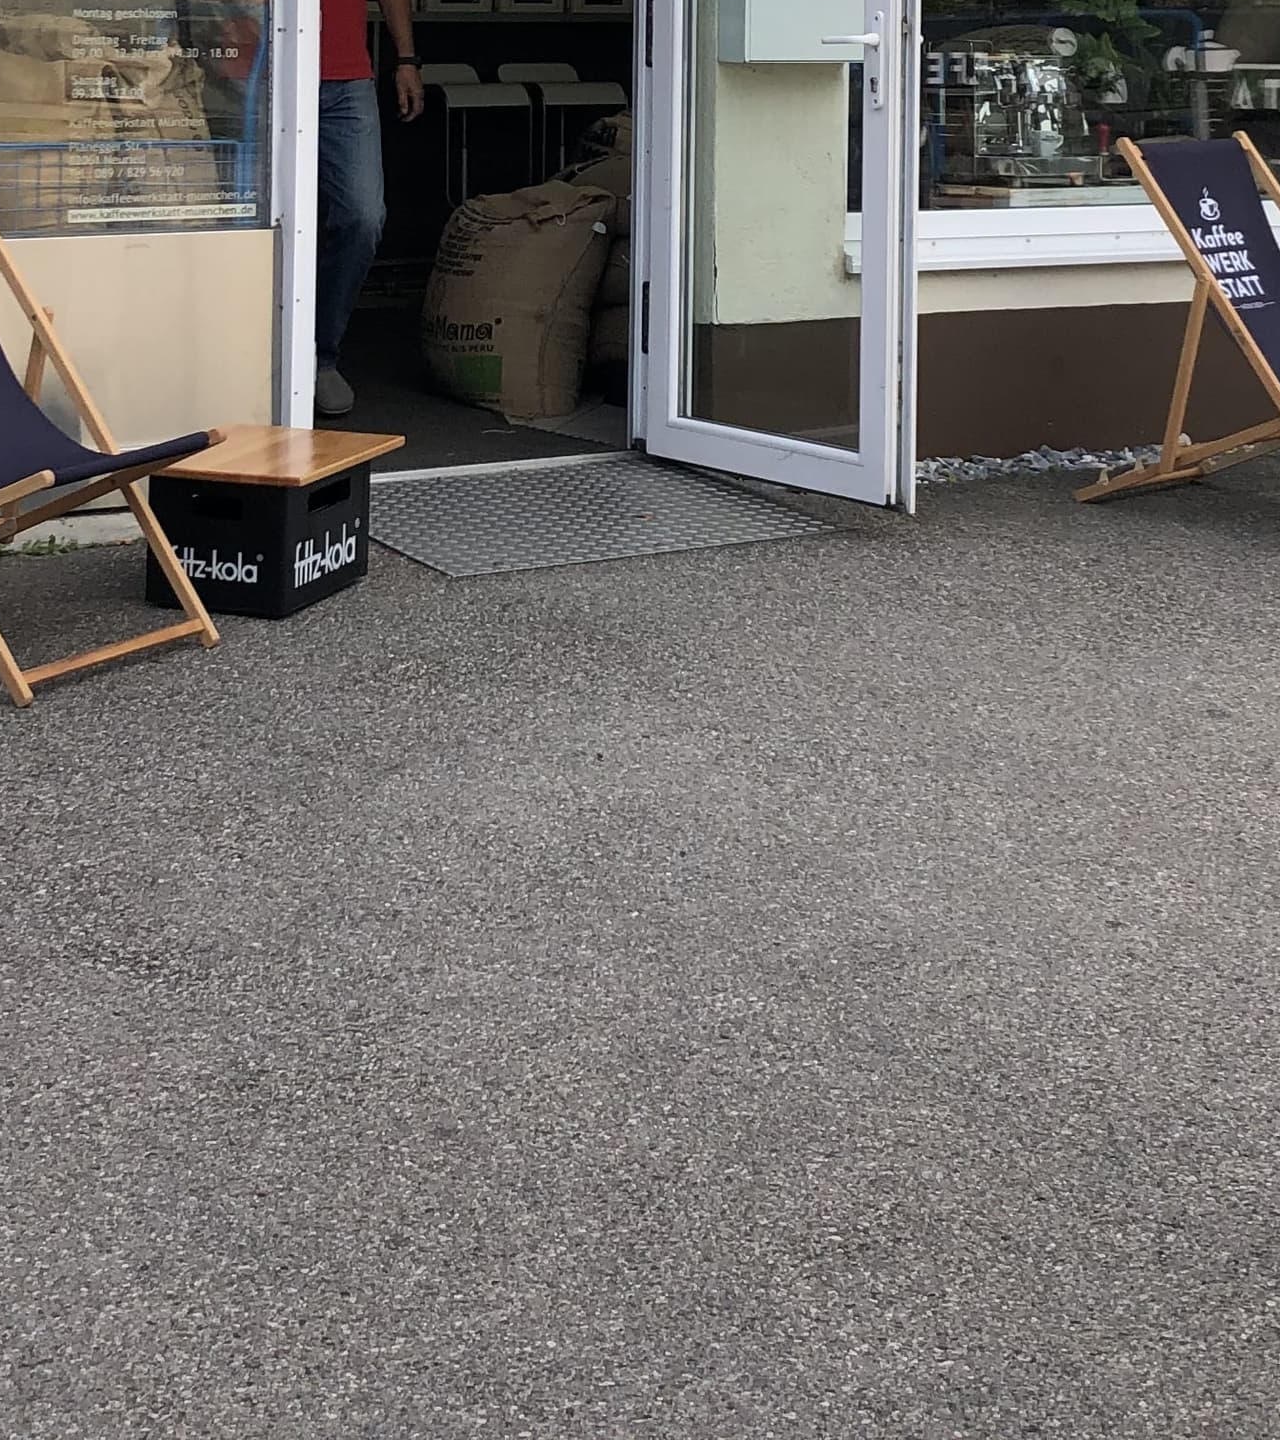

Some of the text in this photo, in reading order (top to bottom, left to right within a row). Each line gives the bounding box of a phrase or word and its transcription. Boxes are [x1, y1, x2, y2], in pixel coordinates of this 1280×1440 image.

[209, 47, 239, 58] 18.00
[1191, 224, 1245, 249] Kaffee
[1202, 250, 1256, 274] WERK
[1217, 275, 1265, 299] STATT
[294, 523, 357, 589] fritz-kola
